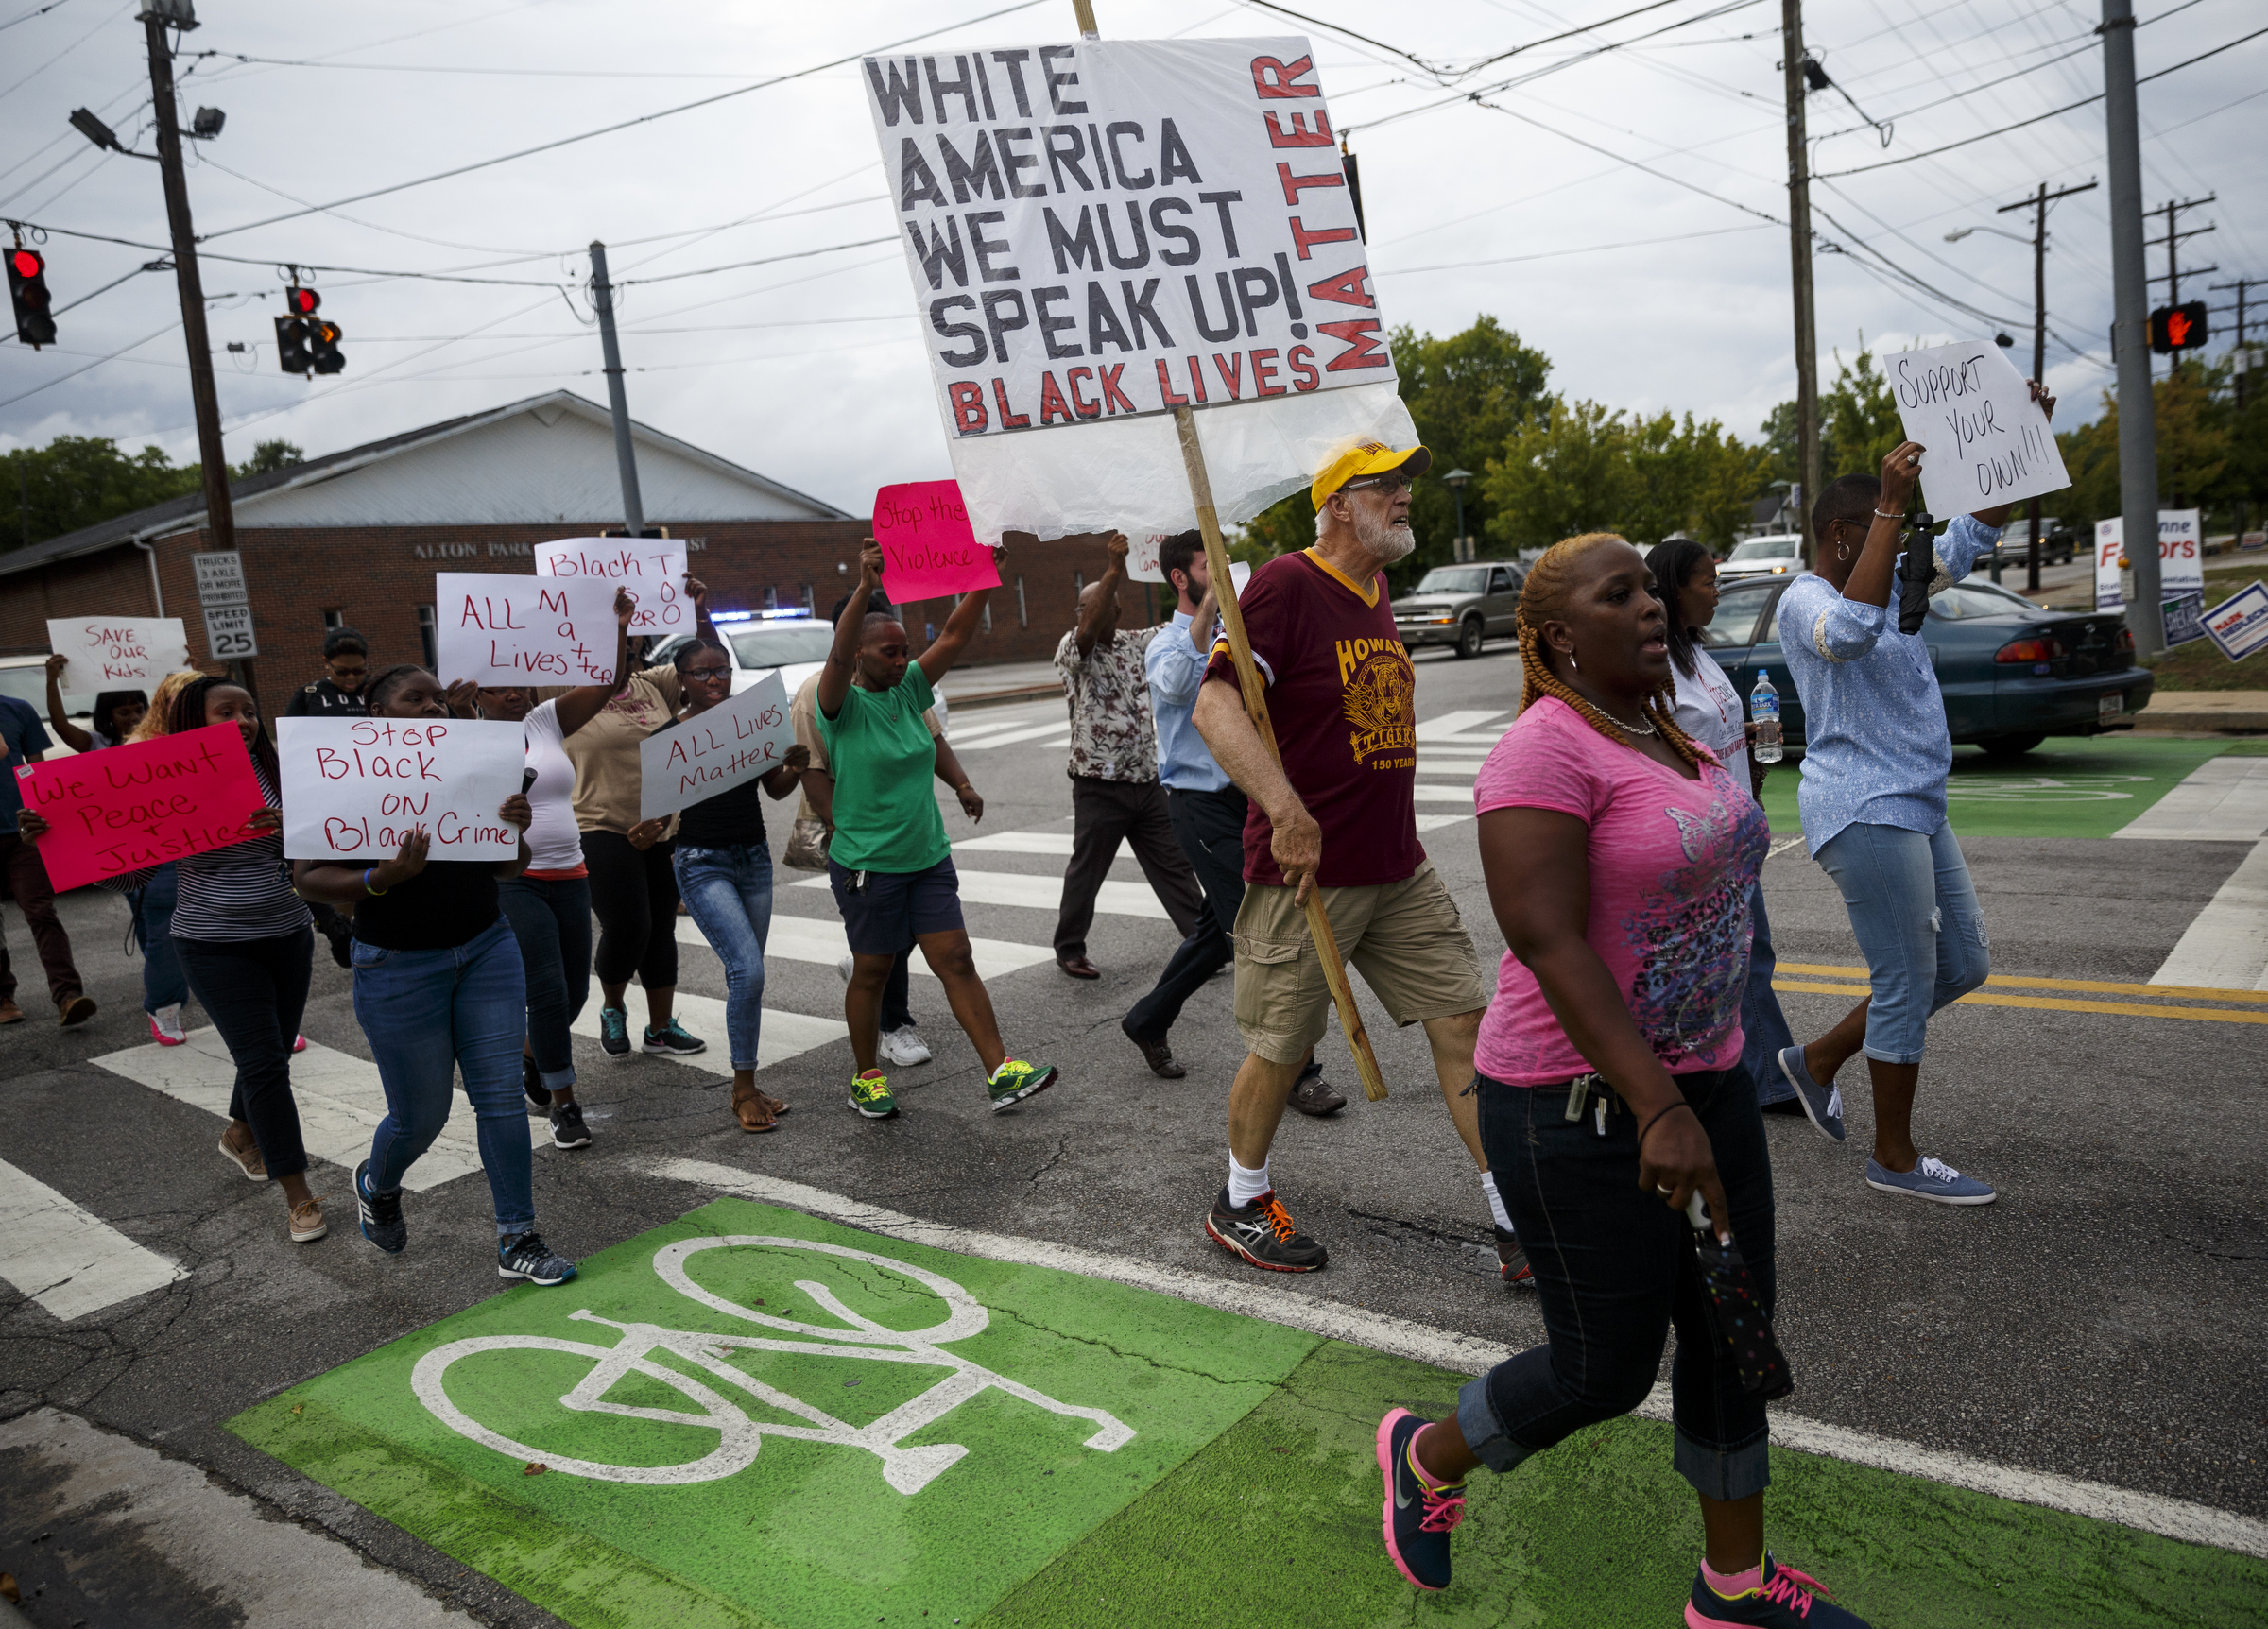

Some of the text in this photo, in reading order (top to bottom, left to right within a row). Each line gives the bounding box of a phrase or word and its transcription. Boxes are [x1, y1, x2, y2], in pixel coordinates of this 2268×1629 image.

[864, 45, 1089, 127] WHITE
[901, 117, 1203, 212] AMERICA
[1250, 54, 1390, 372] MATTER
[905, 190, 1243, 290] WE MUST
[929, 251, 1309, 368] SPEAK UP!
[948, 344, 1320, 437] BLACK LIVES
[1899, 354, 1984, 409] SUPPORT
[1945, 399, 2005, 460] YOUR
[1977, 424, 2051, 496] OWN!!!
[878, 495, 968, 534] Stop the
[197, 557, 237, 567] TRUCKS
[414, 542, 533, 558] ALTON PARK
[549, 550, 643, 578] Black
[888, 544, 973, 574] Violence
[199, 579, 242, 591] OR MORE
[201, 568, 237, 579] 3 AXLE
[208, 608, 249, 621] SPEED
[213, 620, 246, 631] LIMIT
[460, 594, 526, 631] ALL
[85, 625, 136, 647] SAVE
[110, 644, 149, 660] OUR
[215, 632, 253, 655] 25
[103, 663, 146, 680] Kids
[490, 639, 568, 675] Lives
[351, 721, 448, 747] Stop
[666, 704, 782, 770] ALL Lives
[1363, 725, 1416, 752] TIGERS
[31, 742, 223, 806] We Want
[316, 747, 442, 782] Black
[1371, 756, 1415, 770] 150 YEARS
[77, 794, 198, 836] Peace
[438, 811, 516, 846] Crime
[95, 820, 265, 872] Justice
